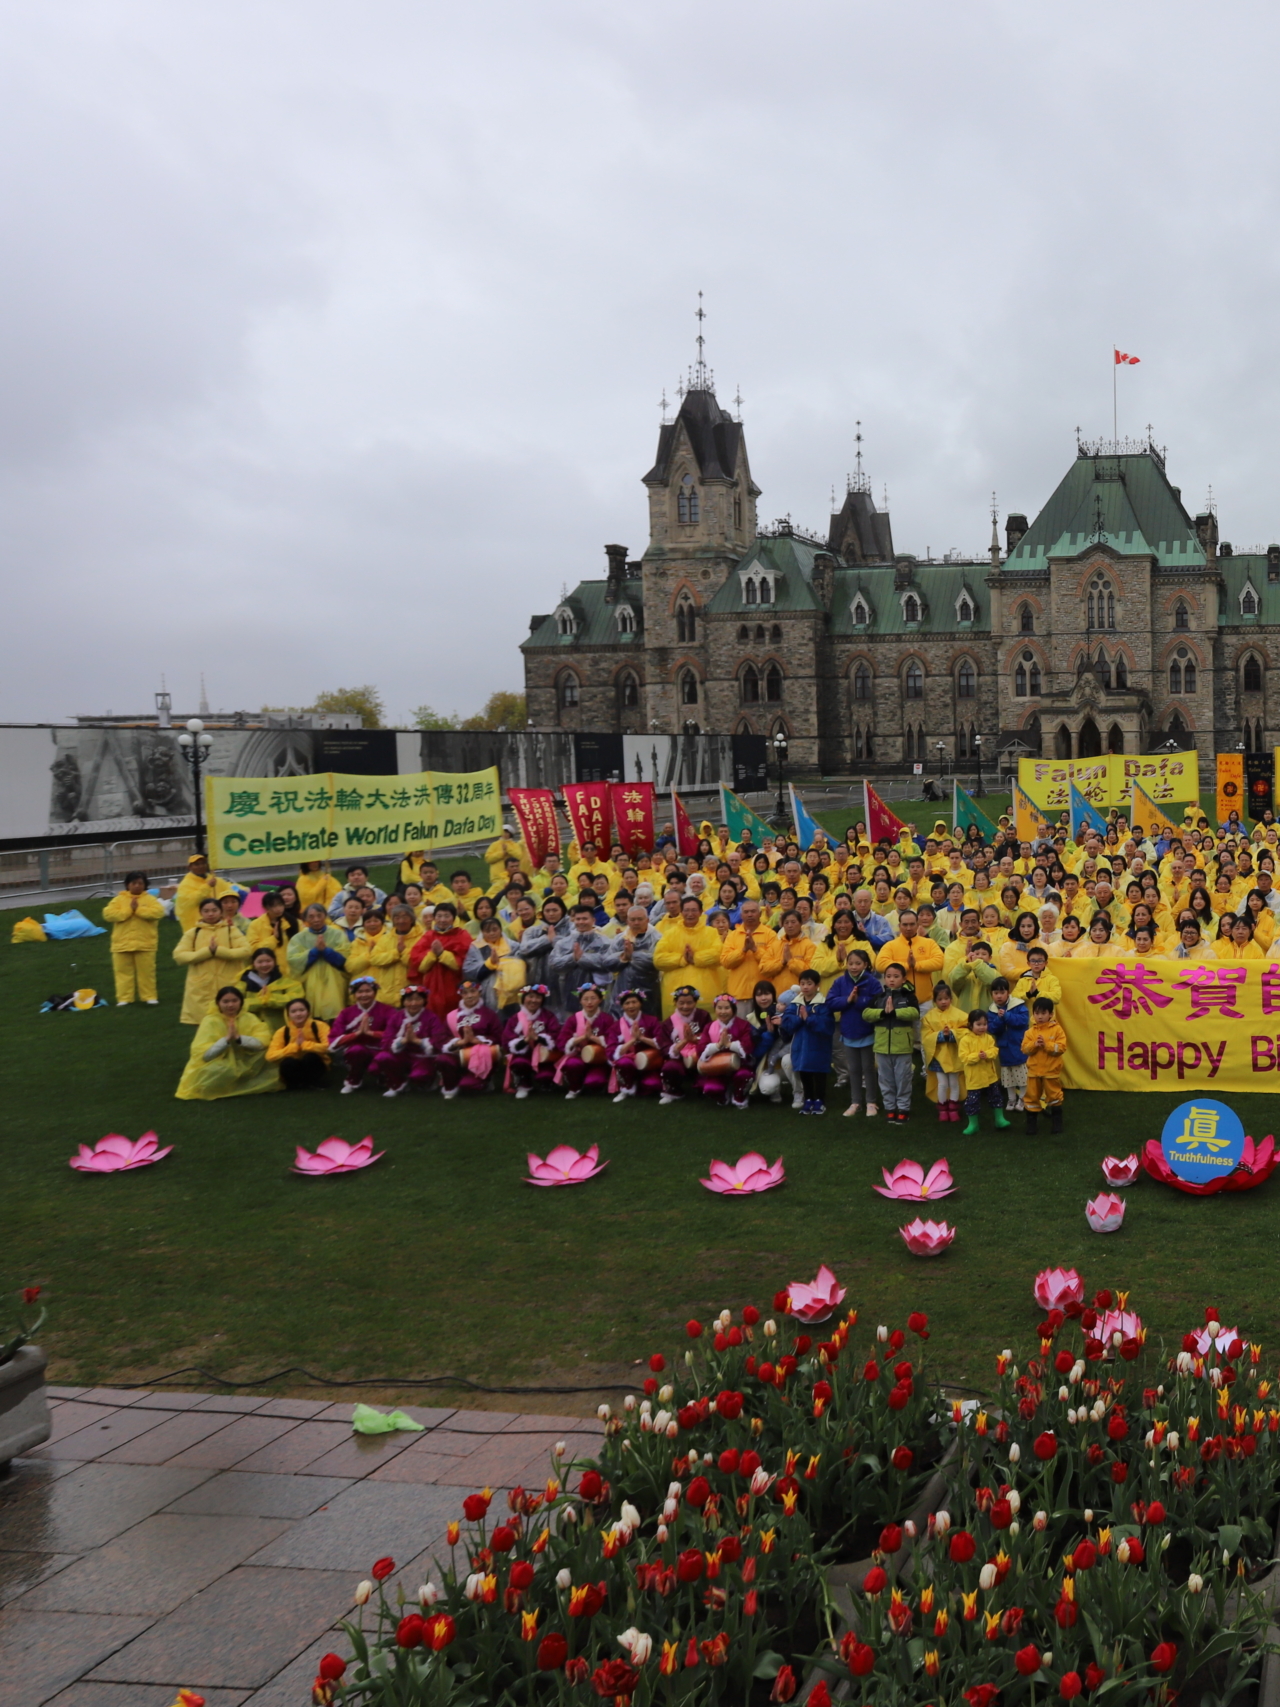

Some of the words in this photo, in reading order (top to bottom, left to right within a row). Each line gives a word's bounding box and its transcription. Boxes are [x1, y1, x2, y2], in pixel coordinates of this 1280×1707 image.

[1034, 762, 1107, 783] Falun
[1124, 758, 1183, 778] Dafa
[223, 827, 339, 857] Celebrate
[346, 824, 400, 846] World
[403, 820, 439, 842] Falun
[443, 817, 476, 838] Dafa
[477, 814, 497, 834] Day
[590, 796, 605, 849] DAFA
[1098, 1031, 1227, 1080] Happy
[1169, 1150, 1234, 1166] Truthfulness
